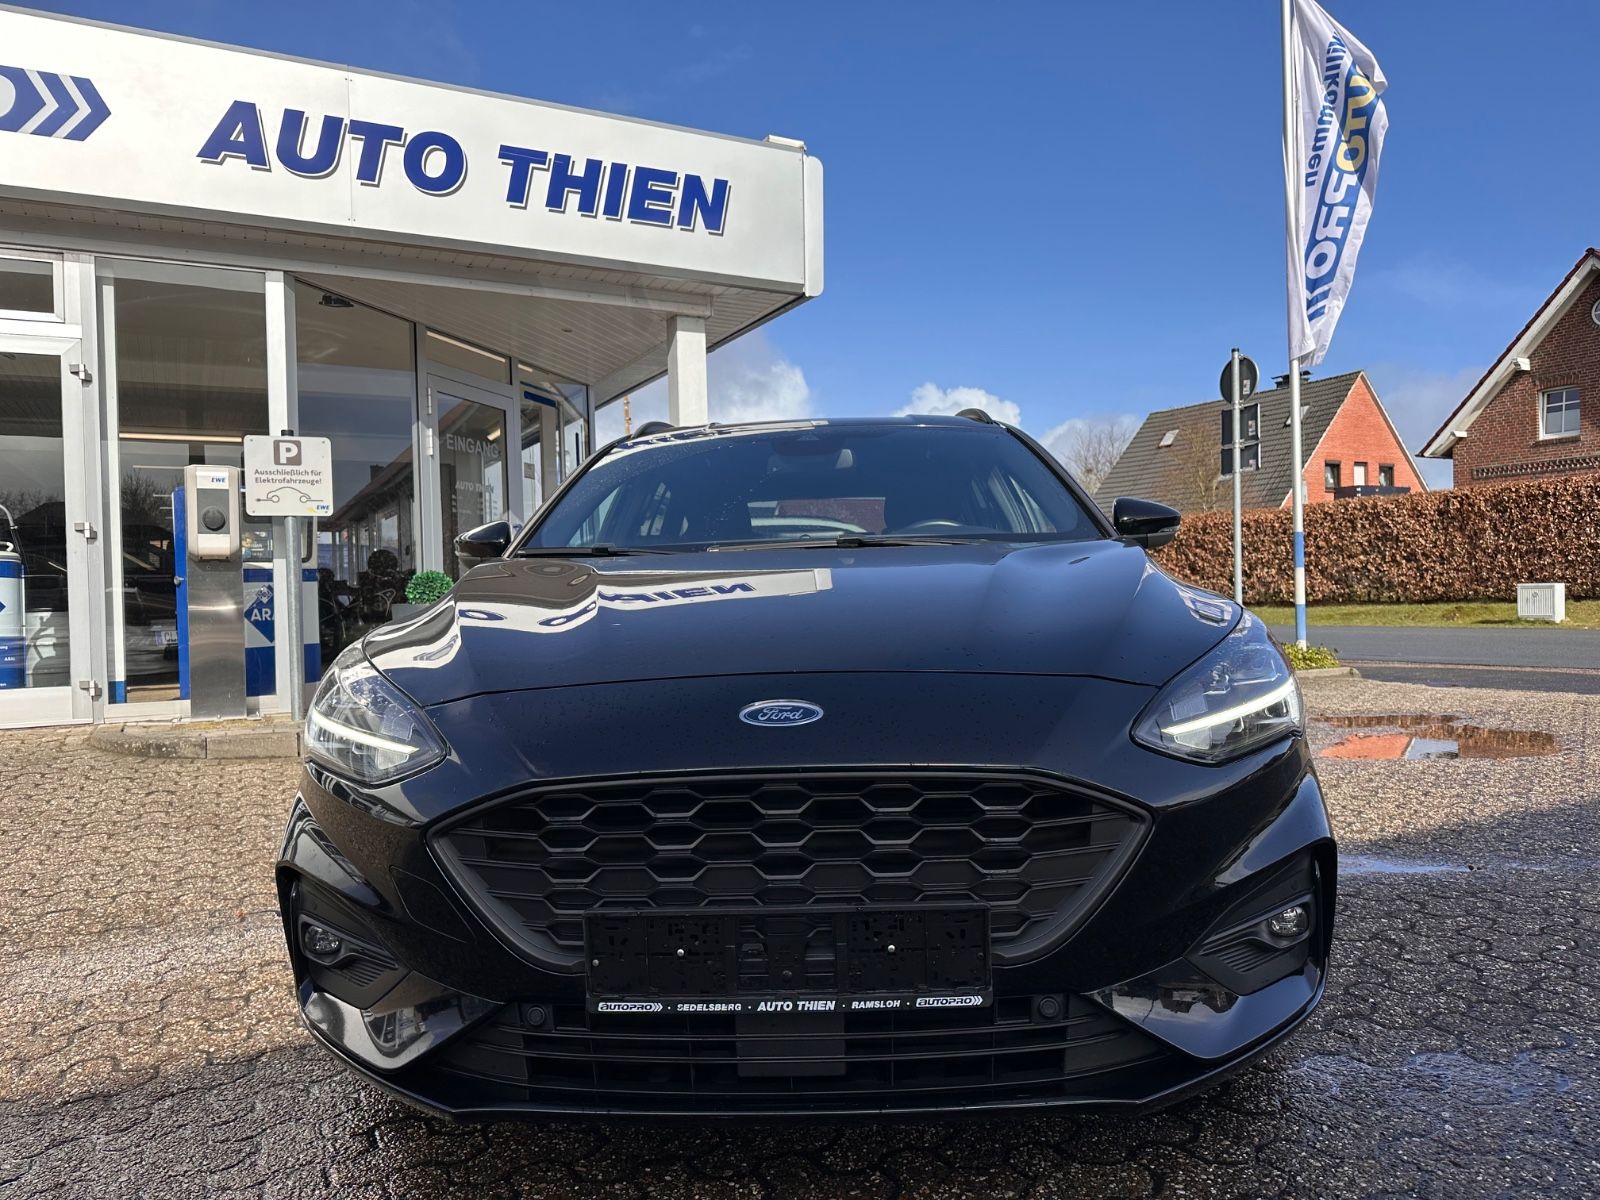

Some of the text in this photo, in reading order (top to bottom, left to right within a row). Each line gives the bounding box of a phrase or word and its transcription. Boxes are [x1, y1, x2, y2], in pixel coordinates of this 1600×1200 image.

[197, 100, 731, 236] AUTO THIEN
[446, 433, 500, 458] EINGANG
[279, 442, 299, 464] P
[254, 468, 322, 477] Ausschließlich für
[254, 477, 322, 486] Elektrofahrzeuge!
[455, 480, 474, 491] AUTO
[250, 608, 275, 621] AR
[757, 706, 804, 721] Ford
[676, 1003, 742, 1012] SEDELSBERG
[757, 1001, 793, 1012] AUTO
[796, 1000, 836, 1011] THIEN
[851, 999, 901, 1009] RAMSLOH
